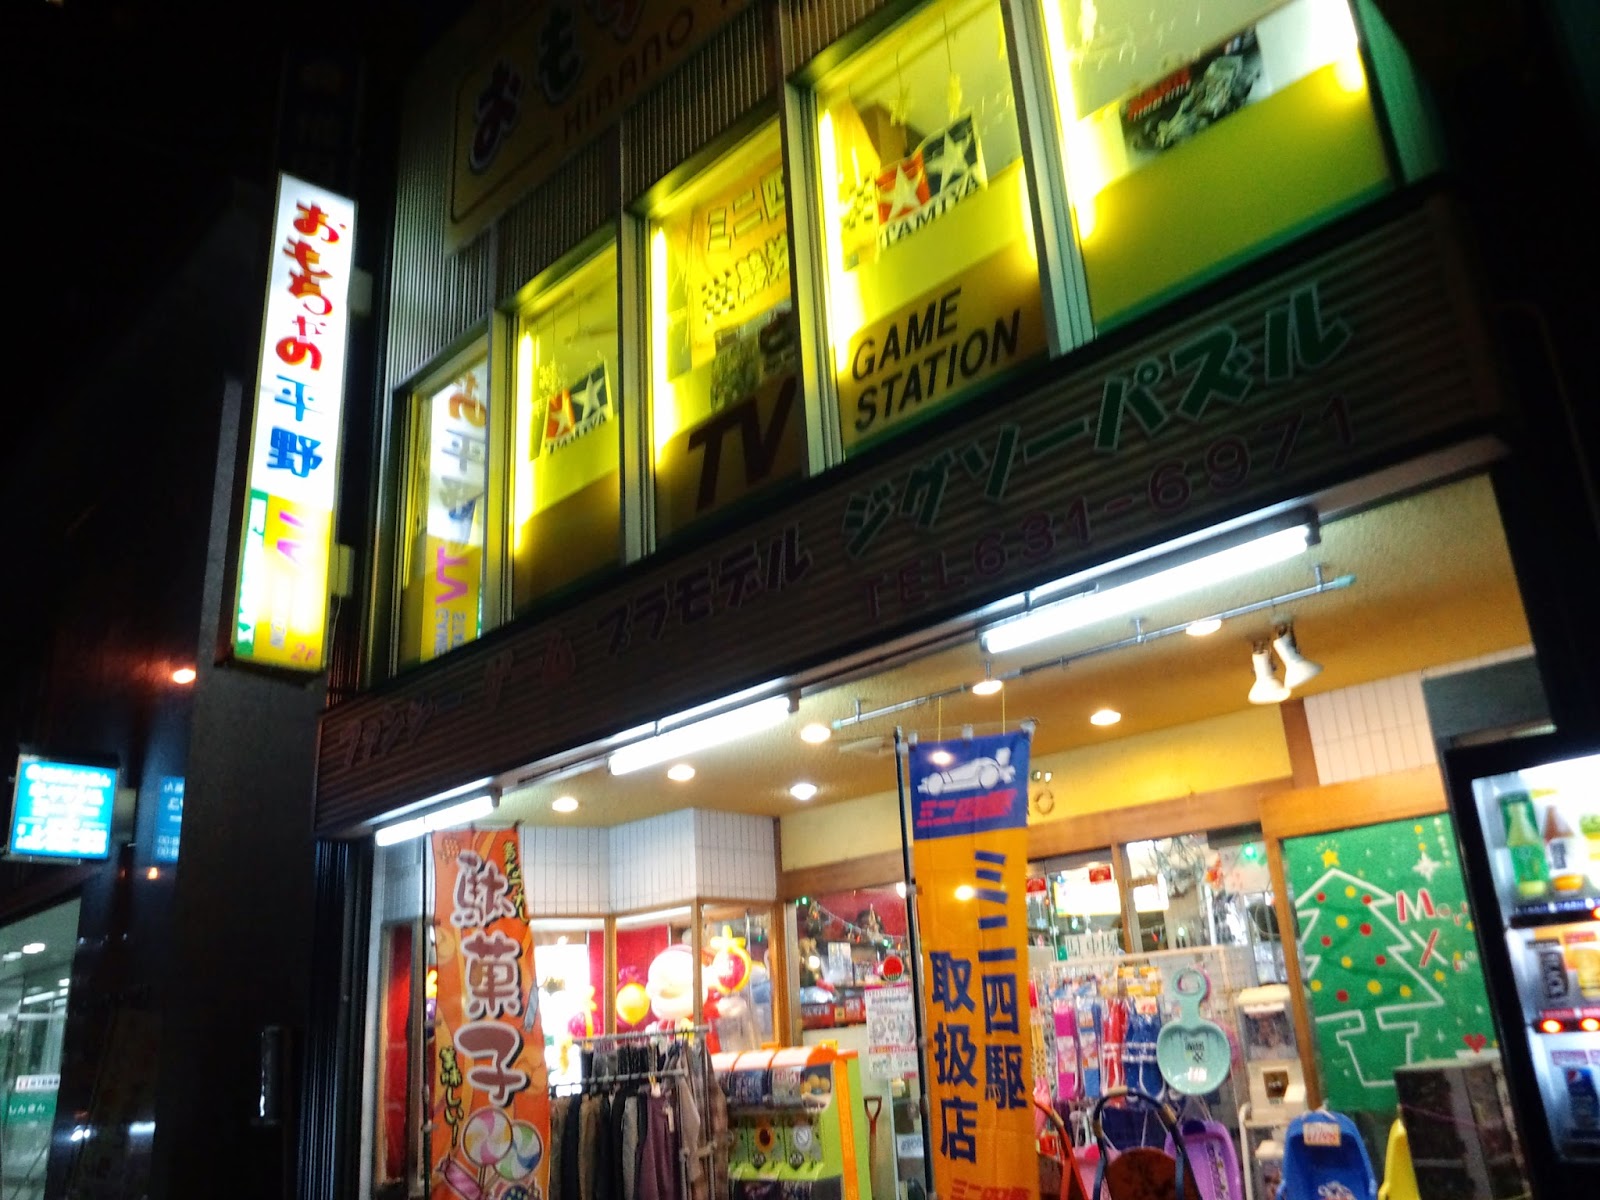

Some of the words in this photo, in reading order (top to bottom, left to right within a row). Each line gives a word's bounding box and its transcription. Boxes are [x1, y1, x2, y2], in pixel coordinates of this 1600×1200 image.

[879, 171, 980, 248] TAMIYA
[852, 287, 962, 382] GAME
[855, 309, 1020, 432] STATION
[595, 520, 813, 656] プラモデル
[842, 282, 1353, 559] ジグソーパズル
[688, 376, 799, 511] TV
[450, 849, 527, 1106] 駄菓子
[928, 951, 978, 1165] 取扱店
[974, 851, 1027, 1110] ミニ四駆
